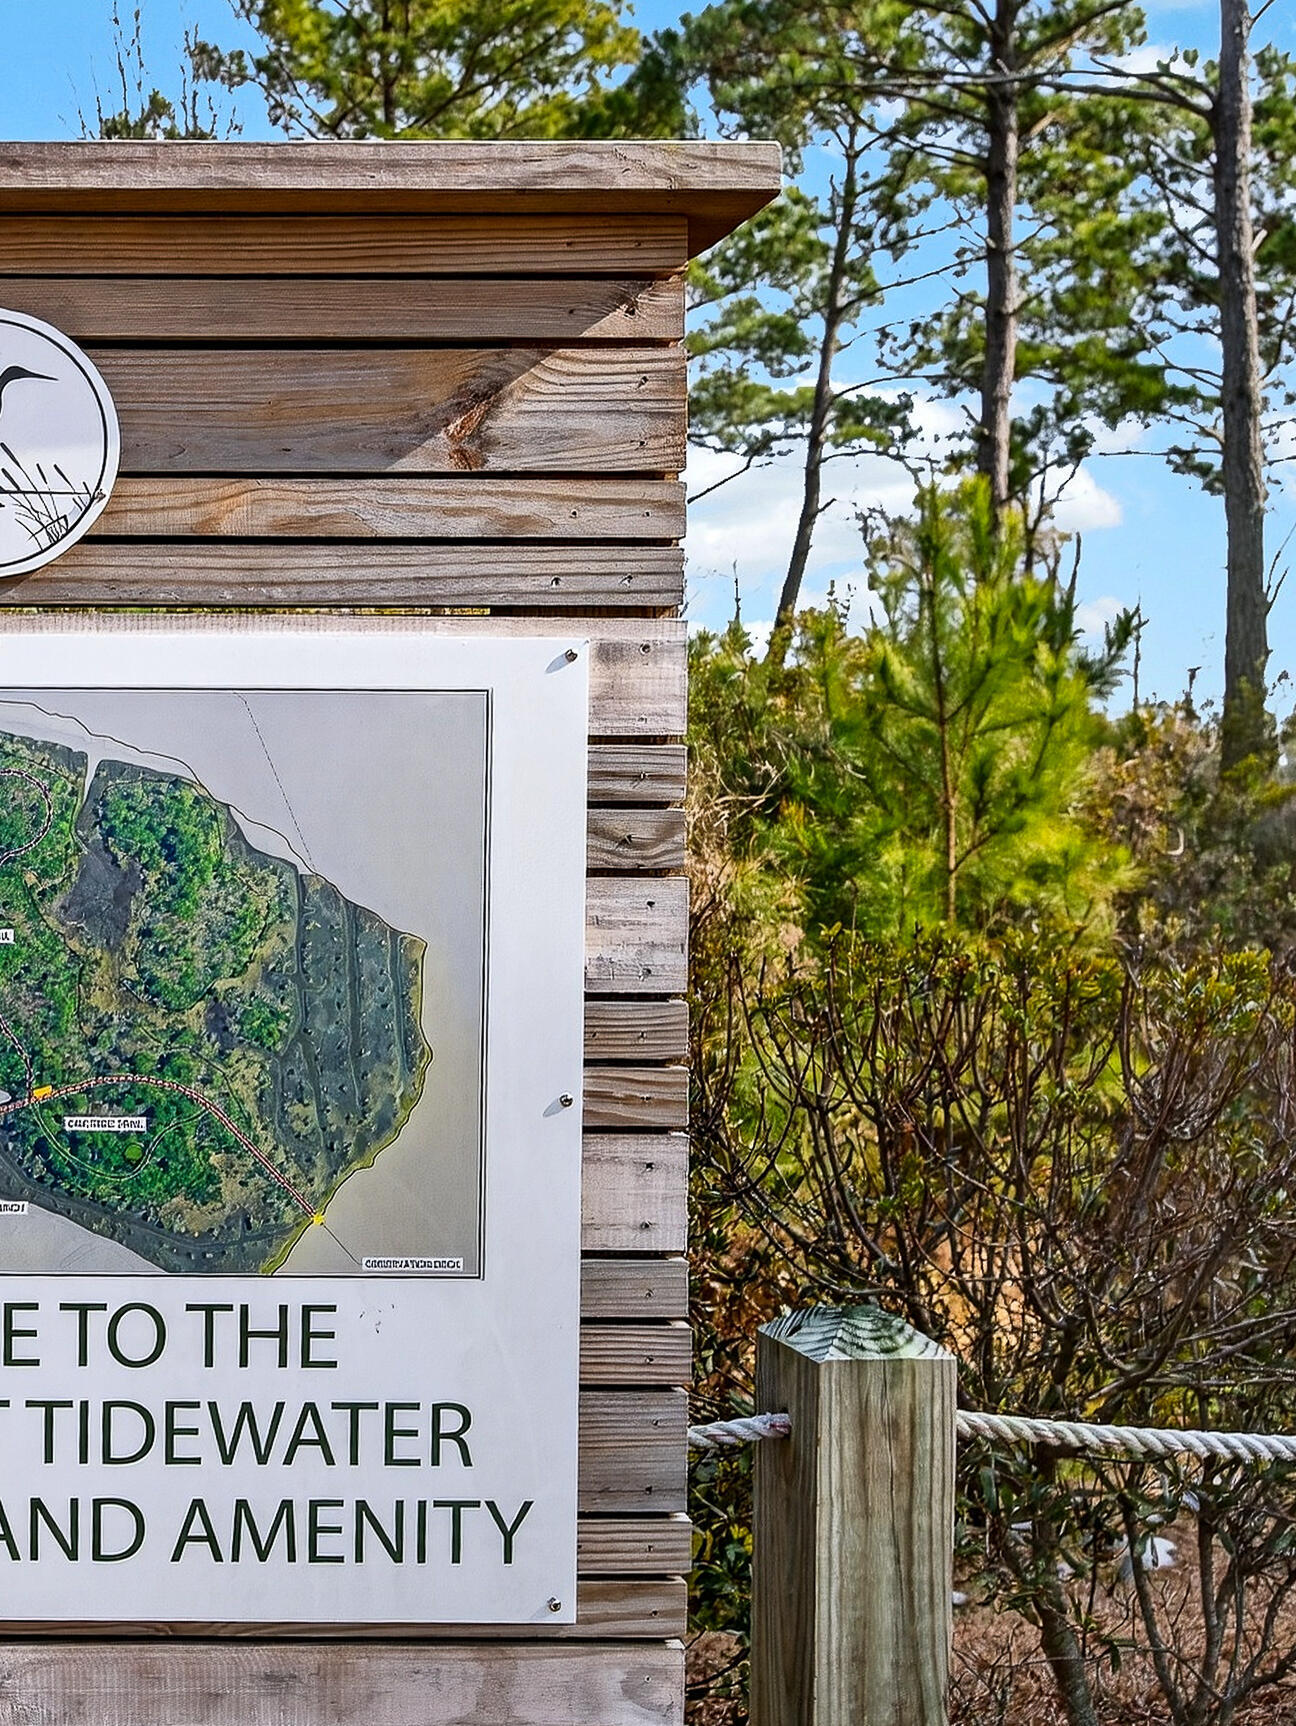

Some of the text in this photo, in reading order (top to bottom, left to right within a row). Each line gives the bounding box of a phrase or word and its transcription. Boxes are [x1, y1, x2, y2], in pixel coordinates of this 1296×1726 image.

[59, 1302, 167, 1369] TO
[185, 1303, 338, 1369] THE
[25, 1399, 473, 1468] TIDEWATER
[170, 1498, 535, 1566] AMENITY
